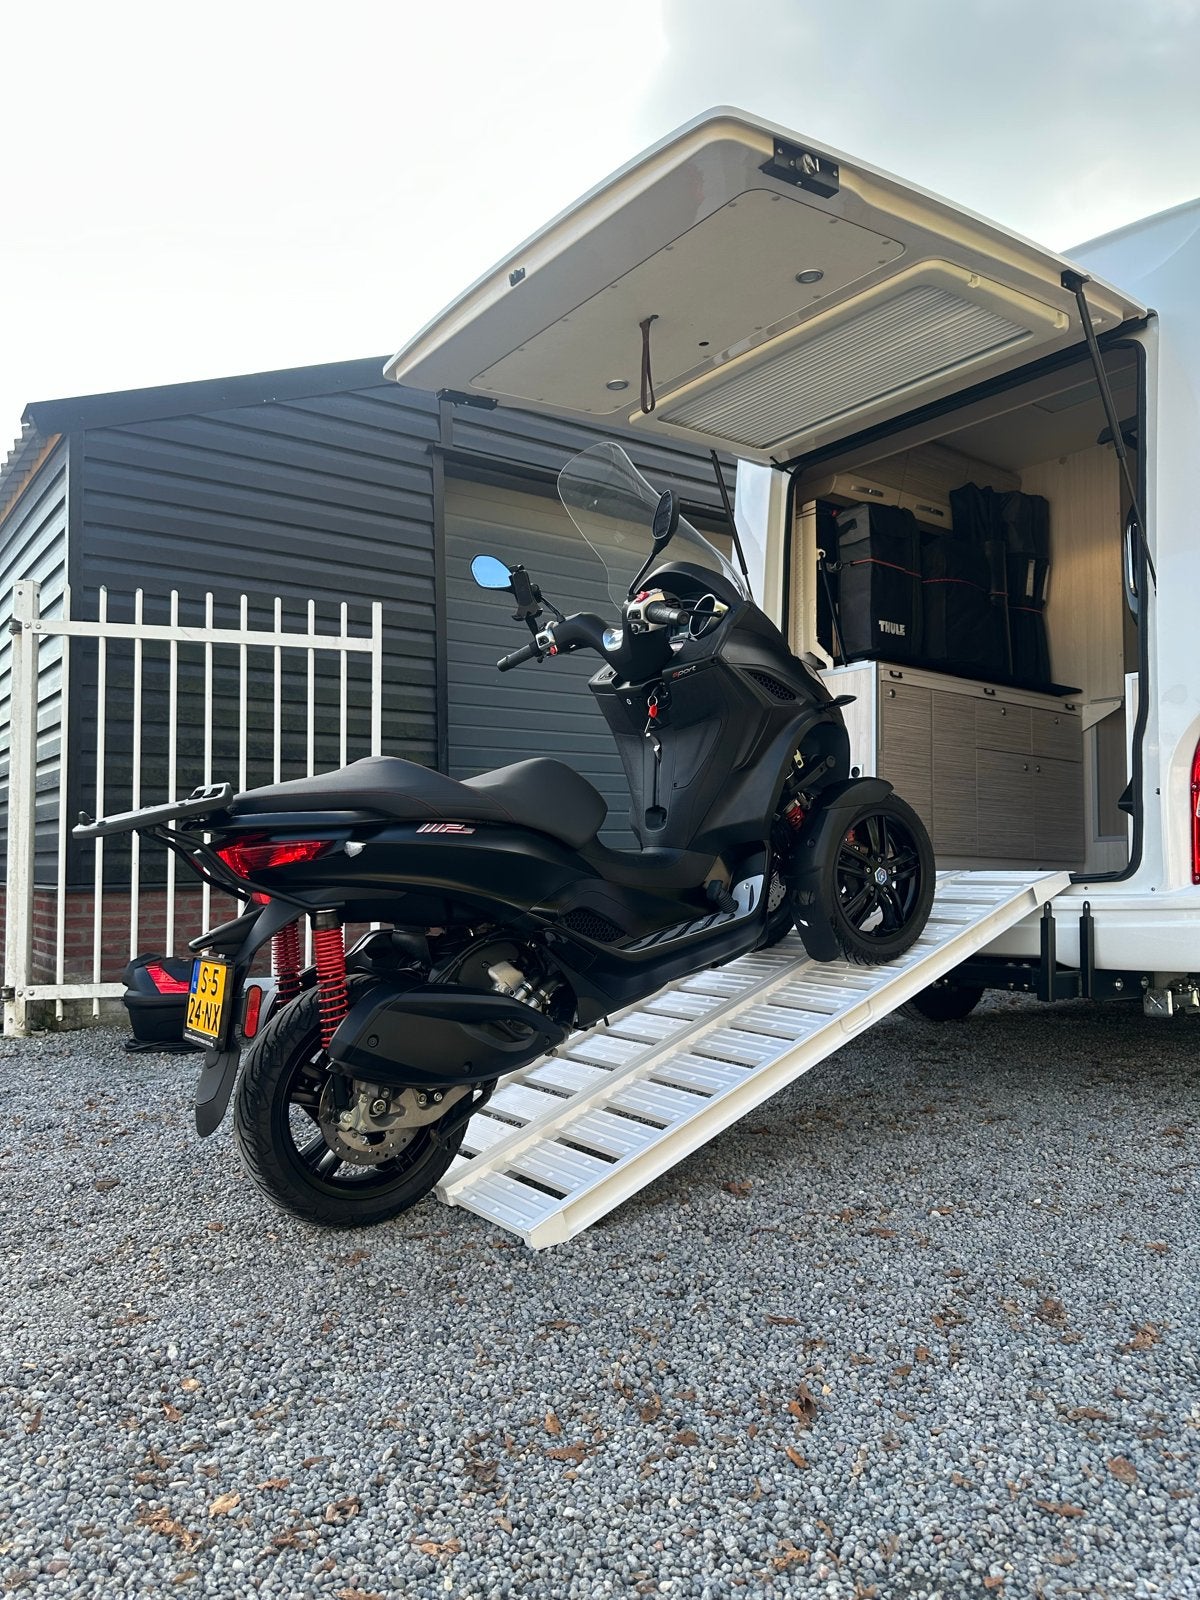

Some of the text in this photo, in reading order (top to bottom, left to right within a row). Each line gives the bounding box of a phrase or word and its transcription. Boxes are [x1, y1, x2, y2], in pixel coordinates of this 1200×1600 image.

[878, 619, 906, 637] THULE
[200, 966, 219, 996] S-5
[188, 997, 220, 1033] 24-NX
